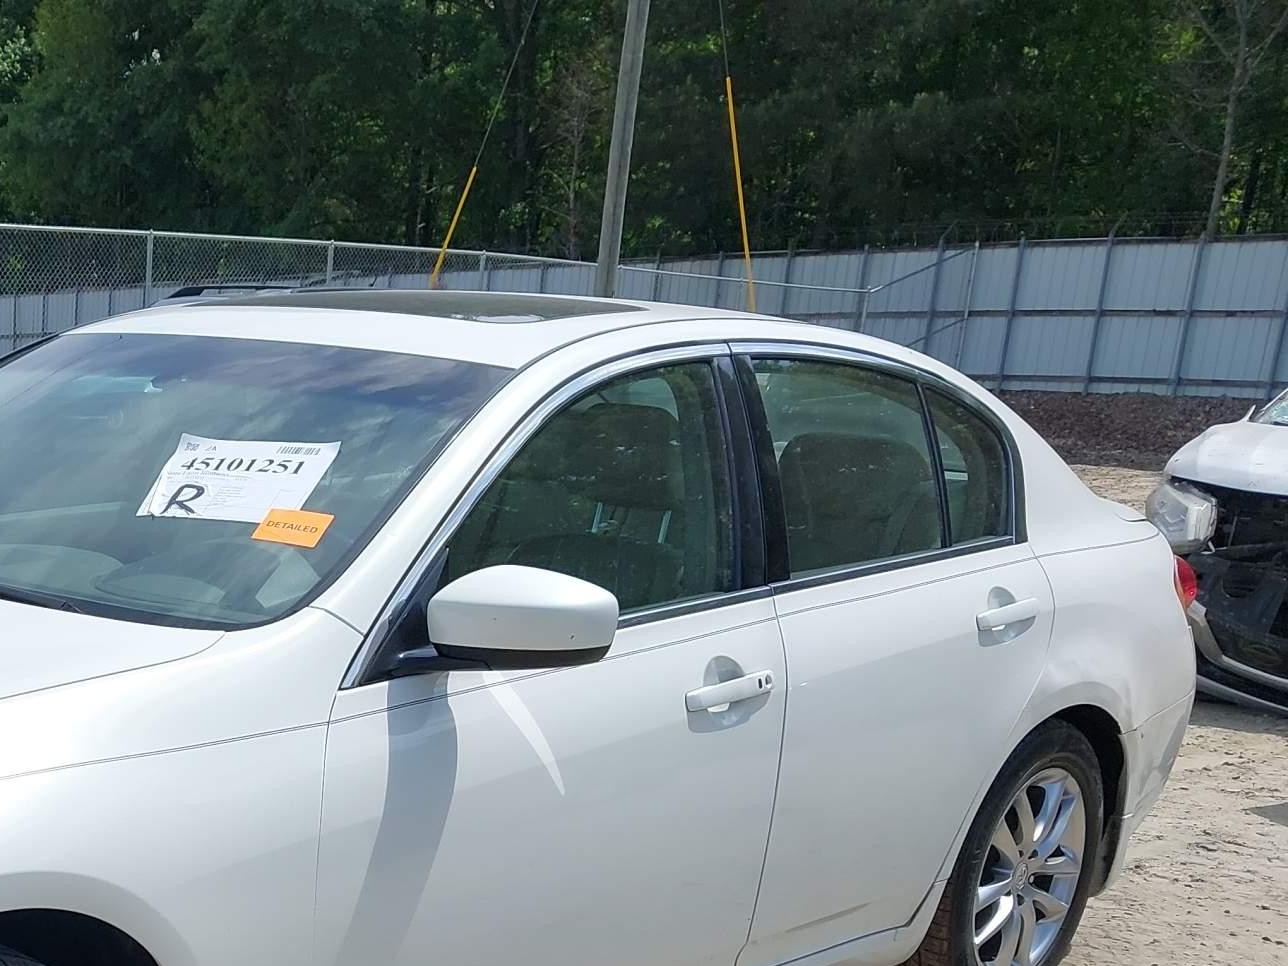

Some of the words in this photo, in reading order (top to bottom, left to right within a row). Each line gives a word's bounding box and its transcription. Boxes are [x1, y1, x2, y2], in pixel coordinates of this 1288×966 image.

[180, 457, 306, 475] 45101251
[160, 484, 205, 514] R
[266, 519, 319, 534] DETAILED
